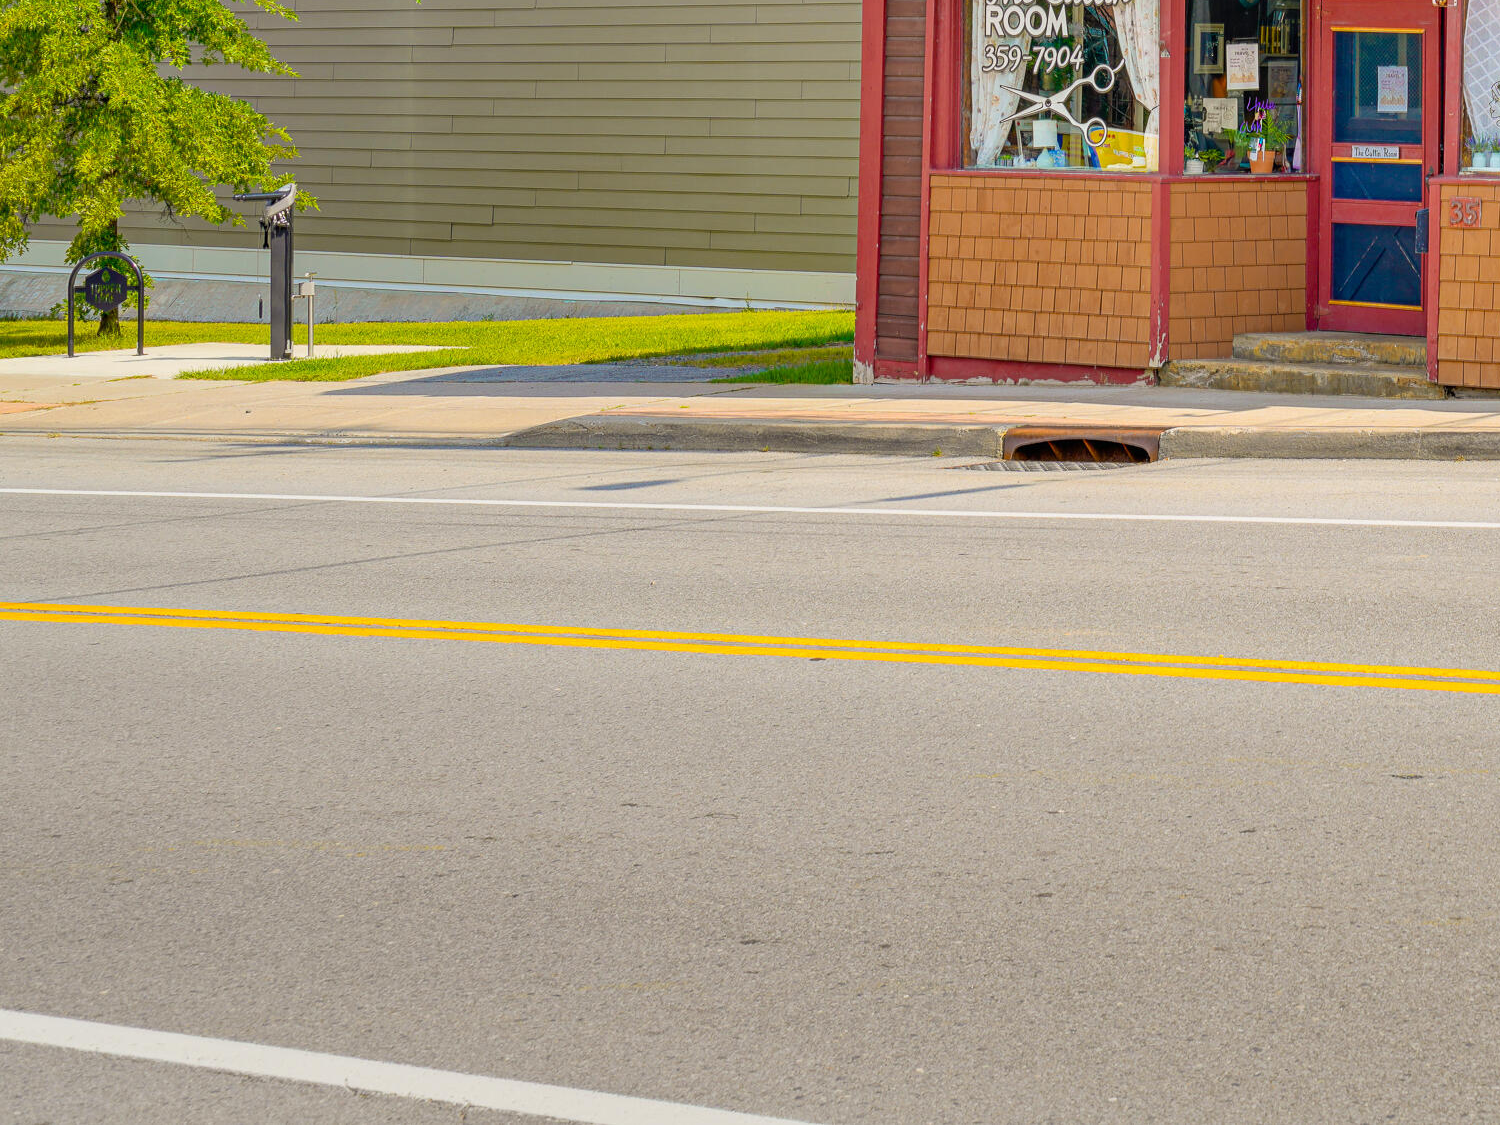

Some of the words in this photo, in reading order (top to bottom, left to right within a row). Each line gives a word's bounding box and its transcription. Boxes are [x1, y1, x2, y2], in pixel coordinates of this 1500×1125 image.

[984, 4, 1069, 37] ROOM
[982, 43, 1085, 74] 359-7904
[1450, 200, 1479, 225] 35
